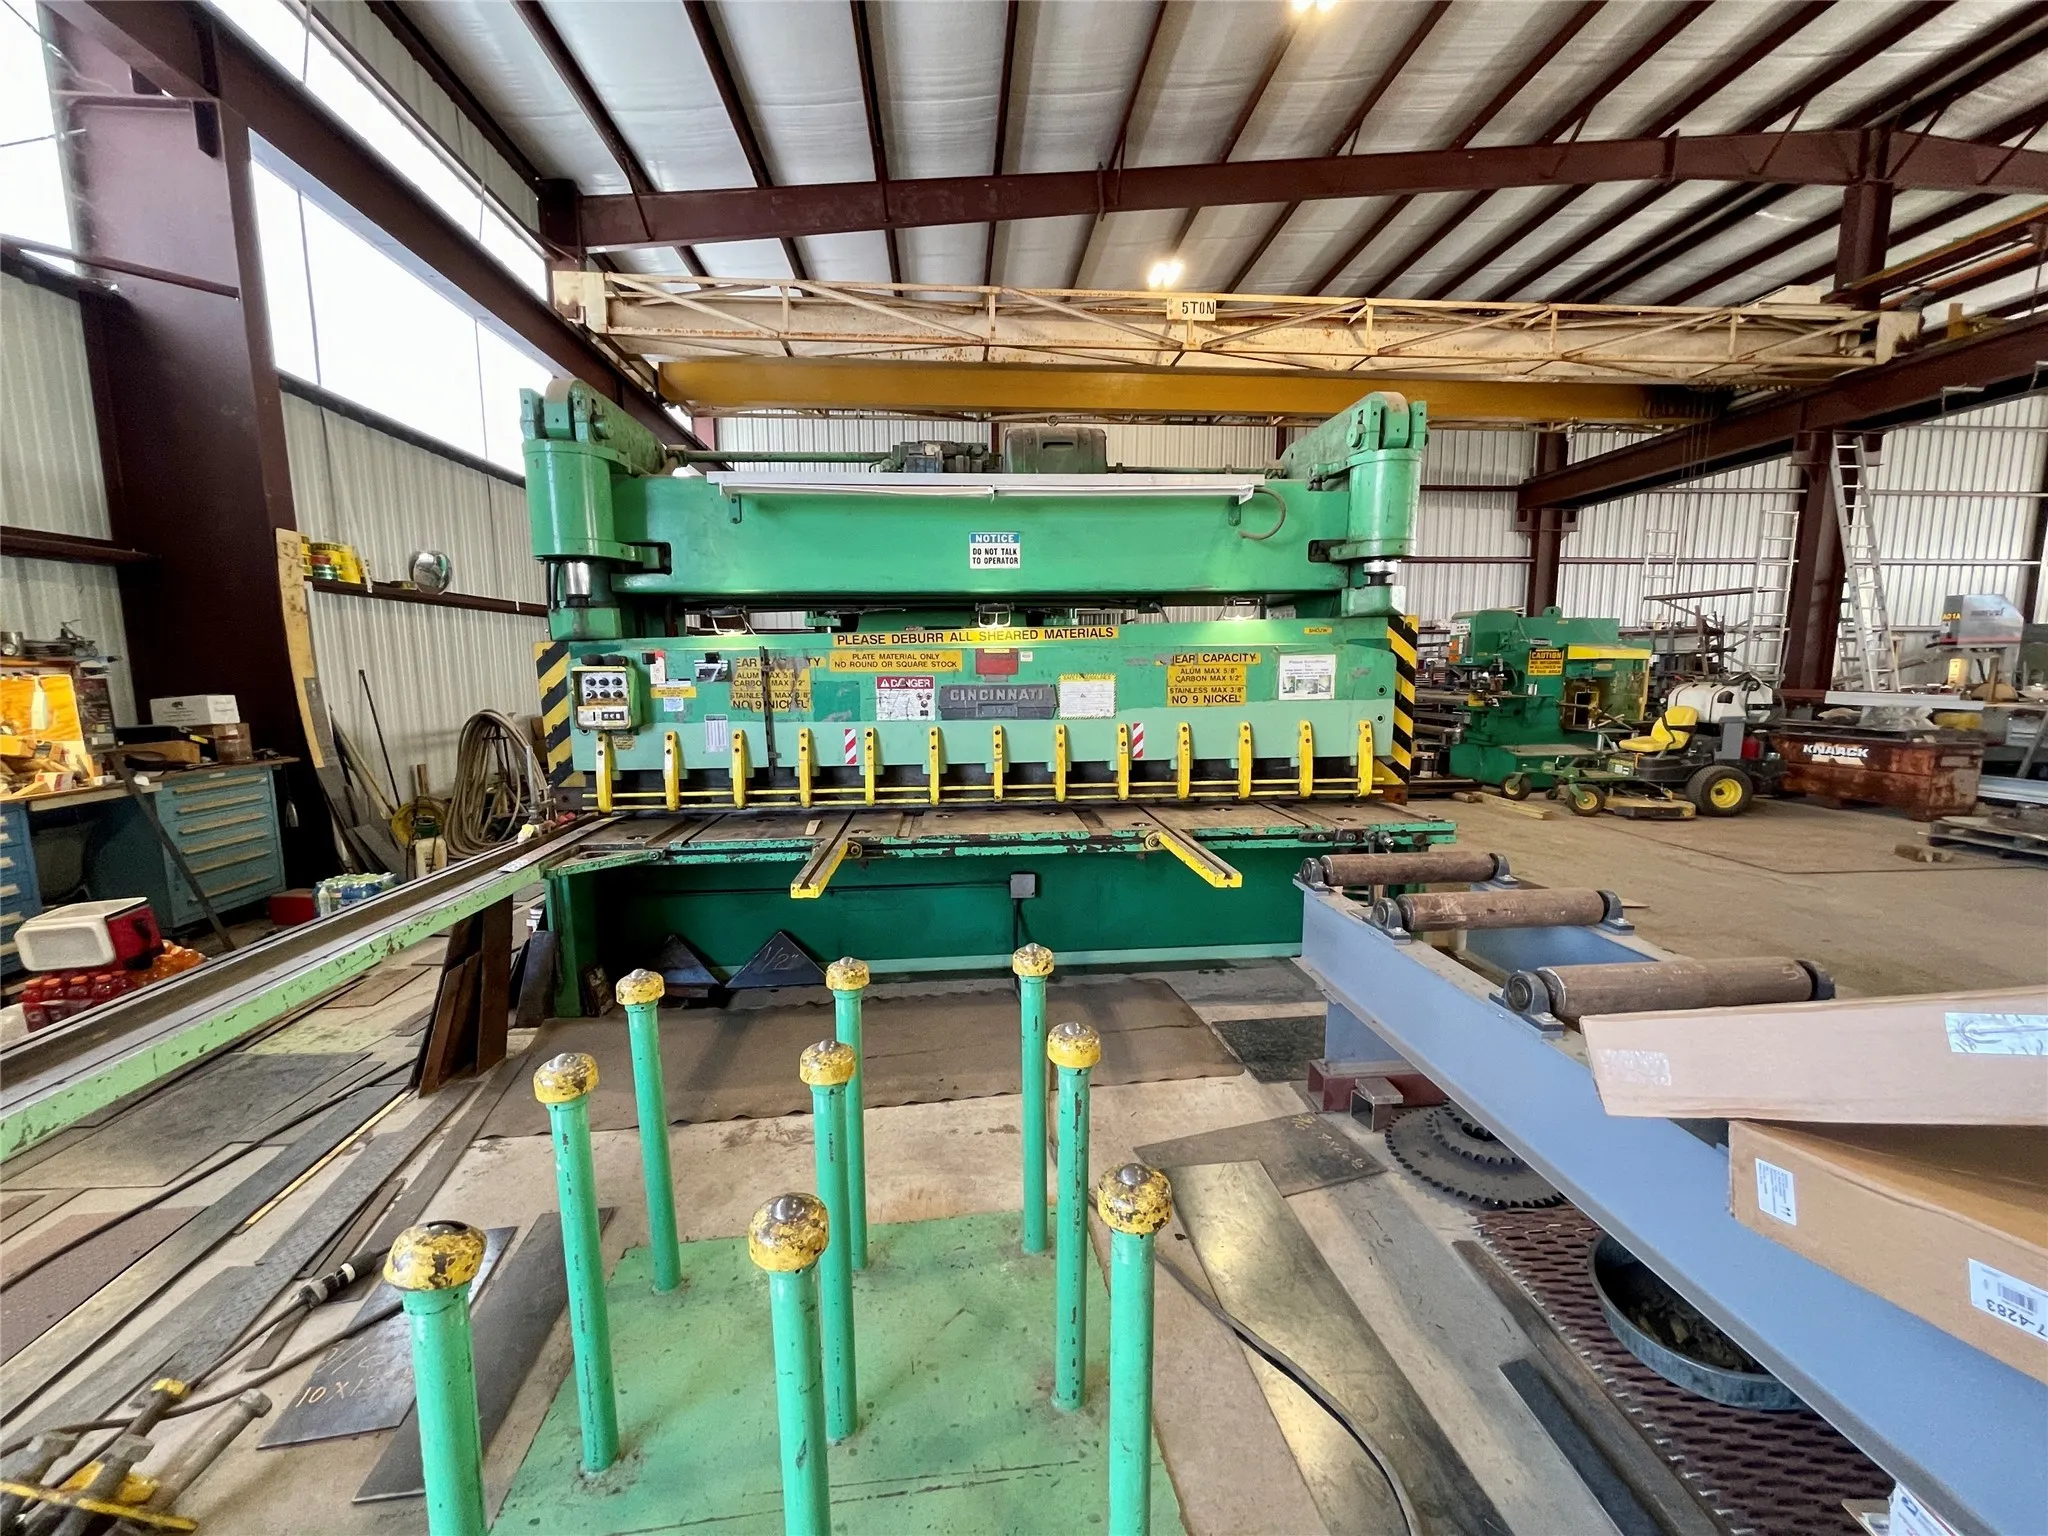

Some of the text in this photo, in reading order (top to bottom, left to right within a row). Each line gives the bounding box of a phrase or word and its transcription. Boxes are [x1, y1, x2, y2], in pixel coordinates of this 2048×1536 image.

[975, 534, 1015, 543] NOTICE
[973, 547, 1017, 555] DO NOT TALK
[837, 626, 1114, 646] PLEASE DEBURR ALL SHEARED MATERIALS
[852, 653, 940, 661] PLATE MATERIAL ONLY
[1202, 652, 1258, 663] CAPACITY
[1531, 651, 1562, 659] CAUTION
[834, 660, 958, 669] NO ROUND OR SQUARE STOCK
[736, 671, 759, 680] ALUM
[1180, 667, 1201, 675] ALUM
[1204, 667, 1221, 675] MAX
[733, 678, 764, 688] CARBO
[771, 679, 790, 687] MAX
[1175, 675, 1207, 683] CARBON
[1210, 674, 1226, 682] MAX
[774, 691, 792, 699] MAX
[950, 686, 1043, 701] CINCINNATI
[1169, 686, 1208, 695] STAINLESS
[1211, 686, 1228, 694] MAX
[1171, 693, 1241, 705] NO 9 NICKEL
[732, 699, 750, 709] NO
[755, 700, 762, 710] 9
